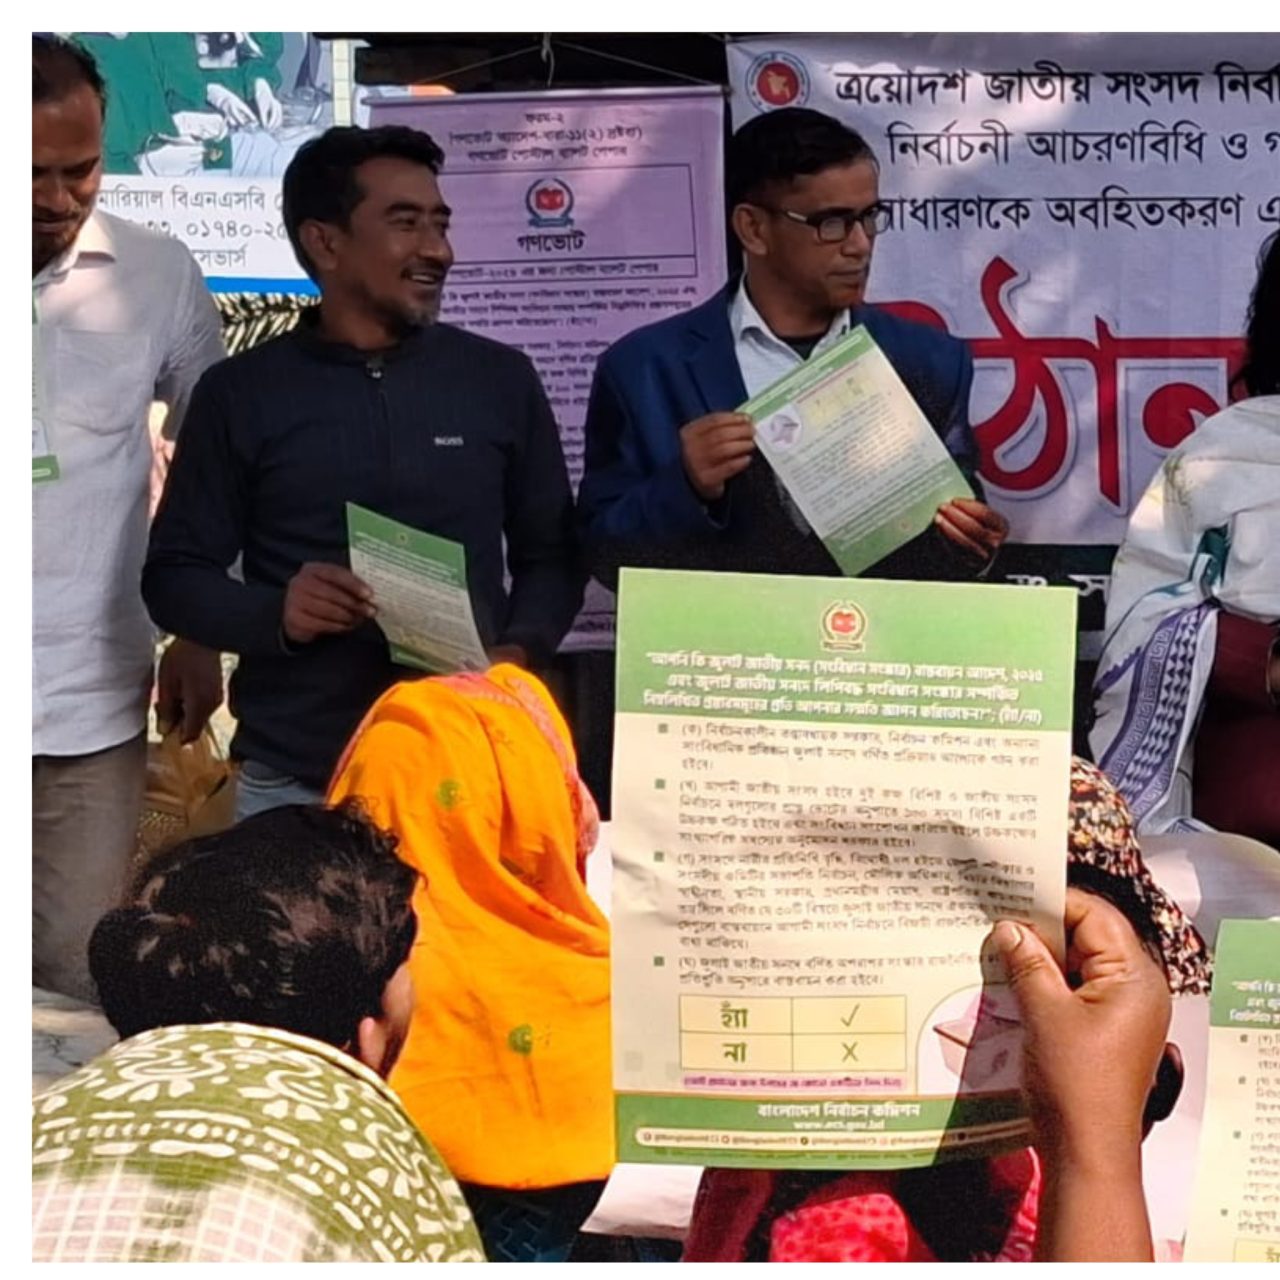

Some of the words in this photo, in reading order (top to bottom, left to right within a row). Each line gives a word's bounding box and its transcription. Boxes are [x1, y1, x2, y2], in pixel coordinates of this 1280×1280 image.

[835, 70, 969, 105] ত্রয়োদশ
[983, 61, 1093, 105] জাতীয়
[1104, 72, 1204, 107] সংসদ
[884, 118, 1013, 165] নির্বাচনী
[1026, 120, 1207, 164] আচরণবিধি
[1221, 133, 1249, 161] ও
[1044, 184, 1246, 230] অবহিতকরণ
[516, 229, 586, 254] গণভোট
[721, 1000, 748, 1028] হ্যাঁ
[723, 1042, 748, 1063] না
